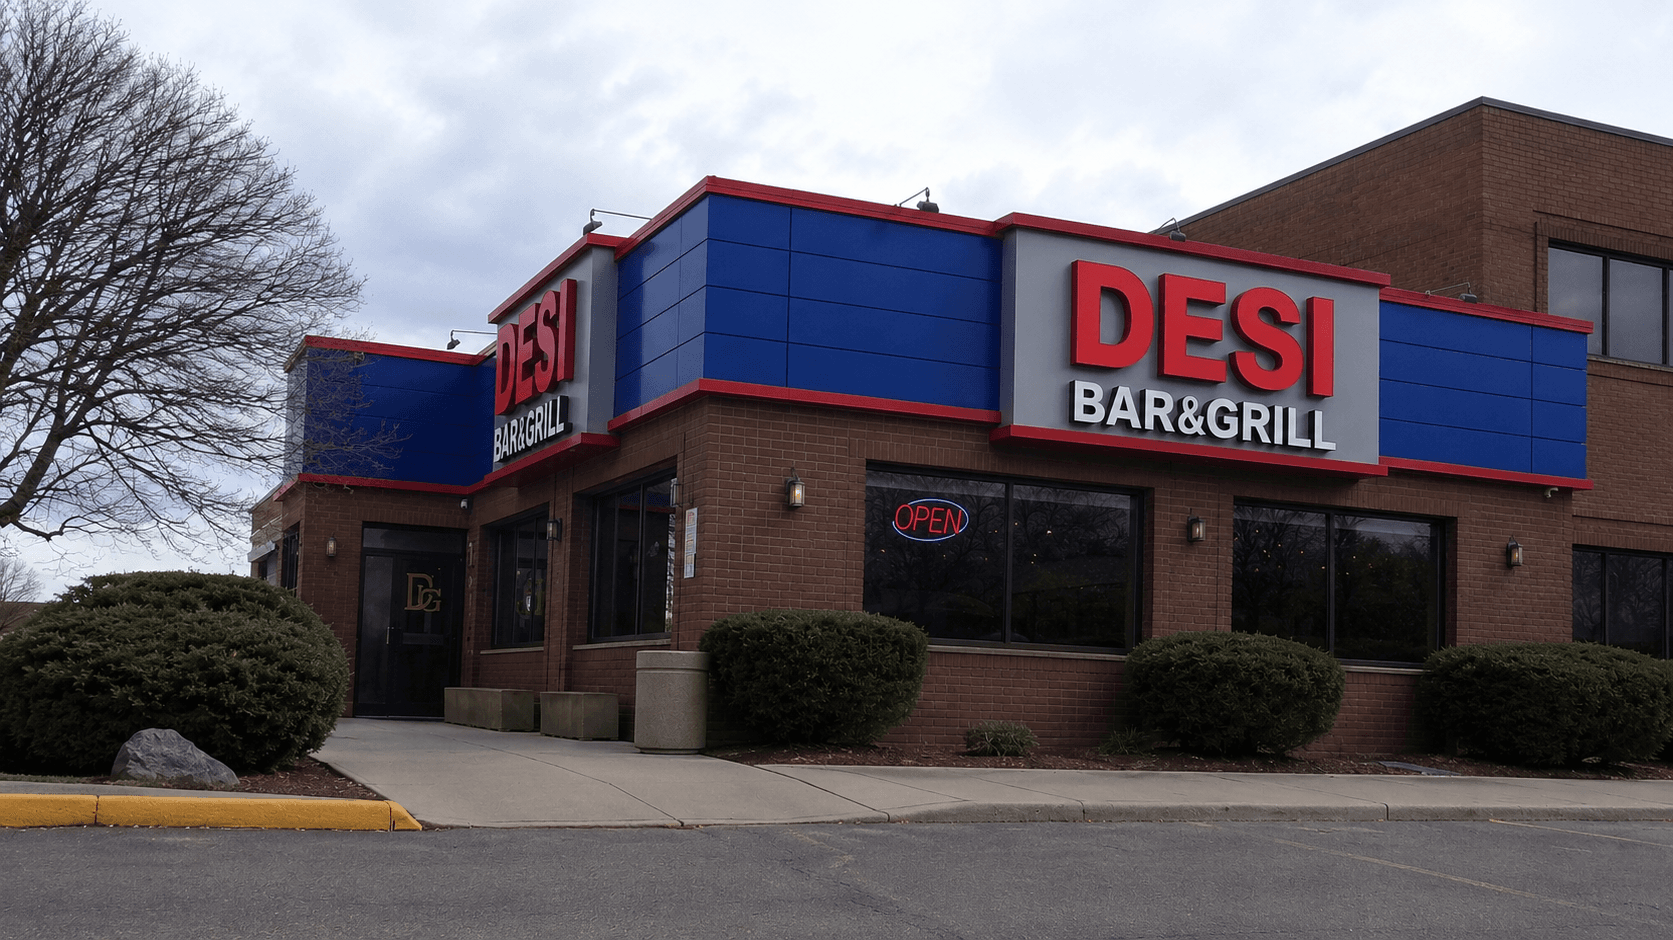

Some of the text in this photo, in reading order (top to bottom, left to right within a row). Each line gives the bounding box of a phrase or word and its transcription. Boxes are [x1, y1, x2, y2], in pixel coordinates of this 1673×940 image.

[495, 278, 577, 416] DESI
[1070, 259, 1335, 398] DESI
[493, 396, 570, 463] BAR&GRILL
[1069, 379, 1337, 451] BAR&GRILL
[895, 503, 962, 535] OPEN
